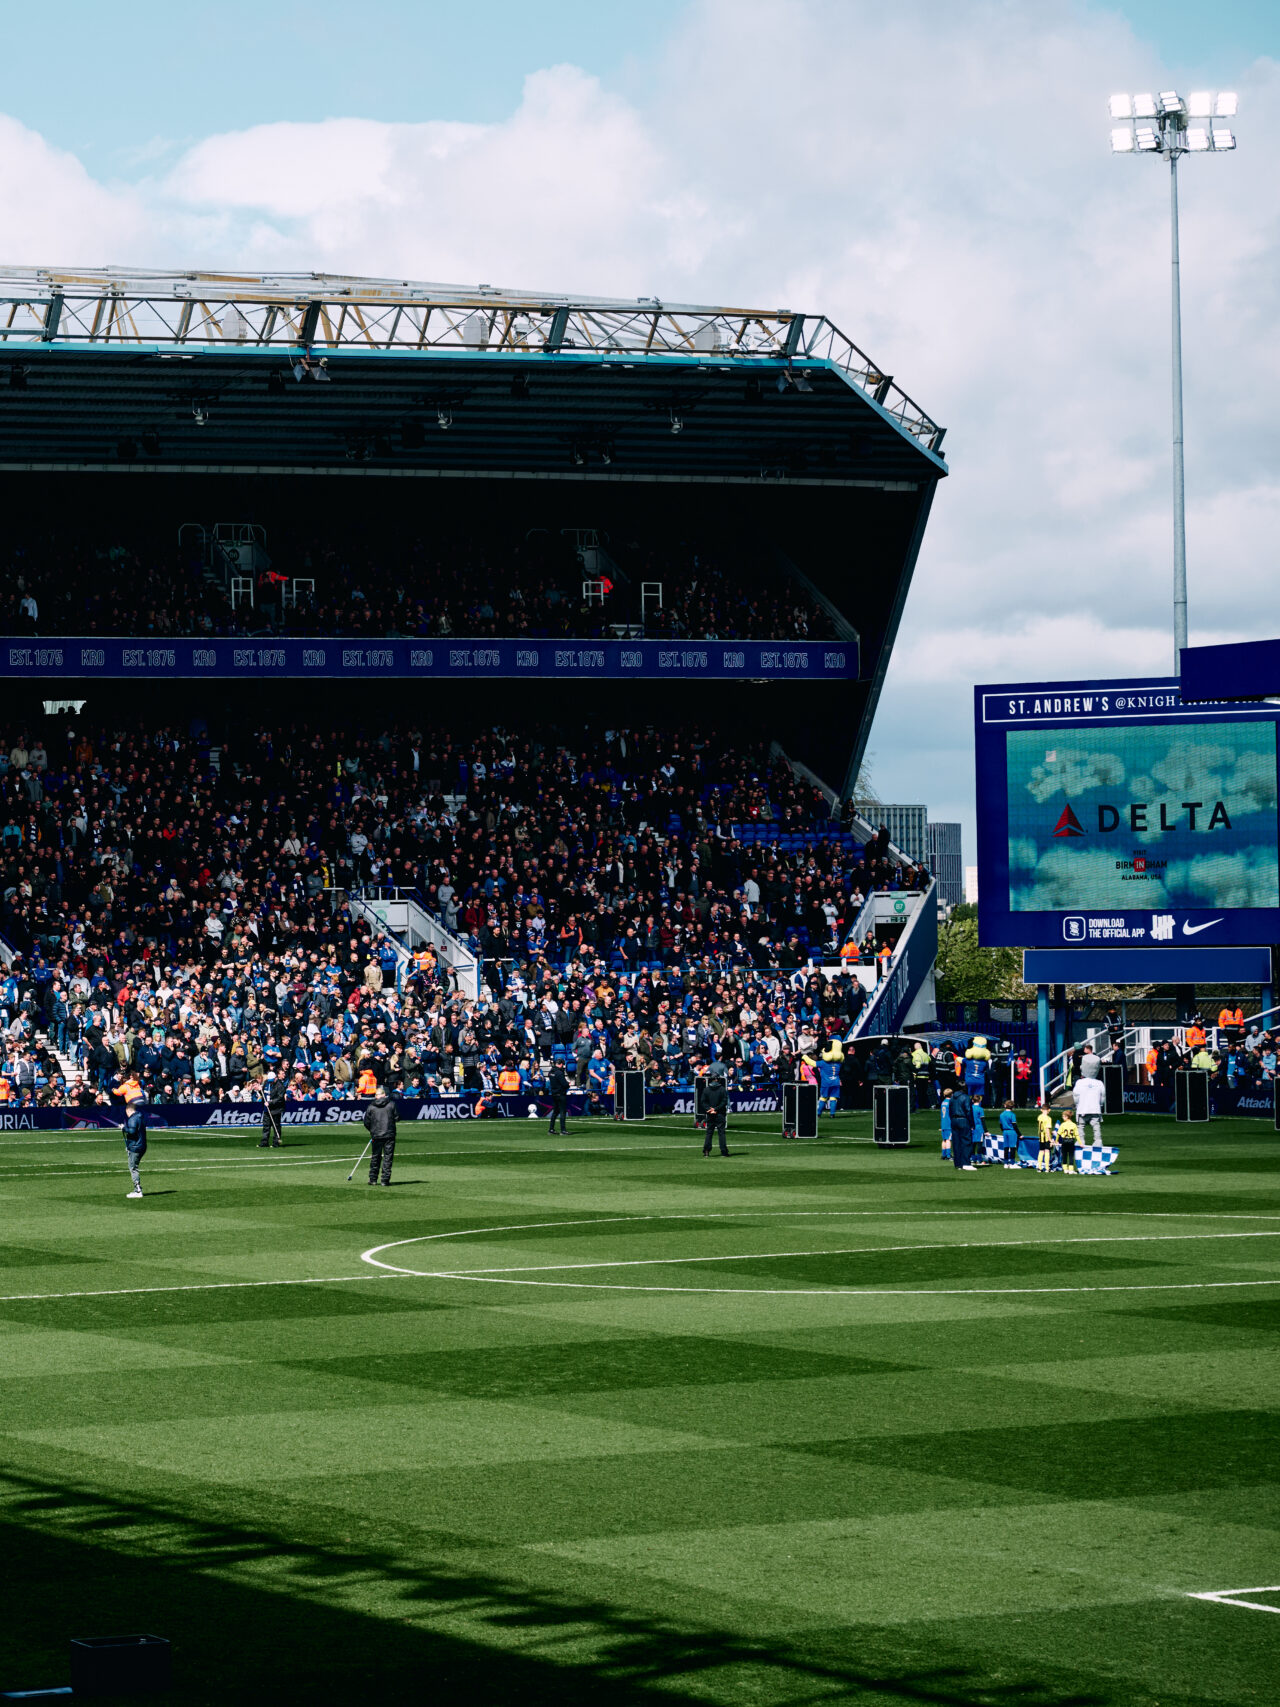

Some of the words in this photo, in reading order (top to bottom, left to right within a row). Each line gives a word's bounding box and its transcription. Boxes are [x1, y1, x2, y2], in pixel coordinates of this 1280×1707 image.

[9, 649, 63, 666] EST.1875
[81, 649, 105, 666] KRO
[122, 649, 176, 667] EST.1875
[192, 650, 216, 667] KRO
[233, 650, 286, 667] EST.1875
[302, 650, 326, 667] KRO
[342, 650, 394, 667] EST.1875
[410, 650, 433, 667] KRO
[449, 650, 500, 667] EST.1875
[516, 651, 539, 668] KRO
[555, 651, 605, 668] EST.1875
[620, 651, 643, 668] KRO
[658, 651, 708, 668] EST.1875
[723, 652, 745, 668] KRO
[760, 652, 809, 669] EST.1875
[824, 652, 846, 669] KRO
[1098, 801, 1232, 833] DELTA
[1115, 860, 1168, 870] BIRMINGHAM
[1088, 918, 1125, 928] DOWNLOAD
[1088, 928, 1102, 939] THE
[1102, 928, 1131, 939] OFFICIAL
[1131, 927, 1145, 938] APP
[416, 1102, 515, 1119] MERCUAL
[736, 1096, 778, 1112] with
[1236, 1096, 1272, 1109] Attack
[206, 1108, 264, 1125] Attac
[281, 1107, 321, 1123] with
